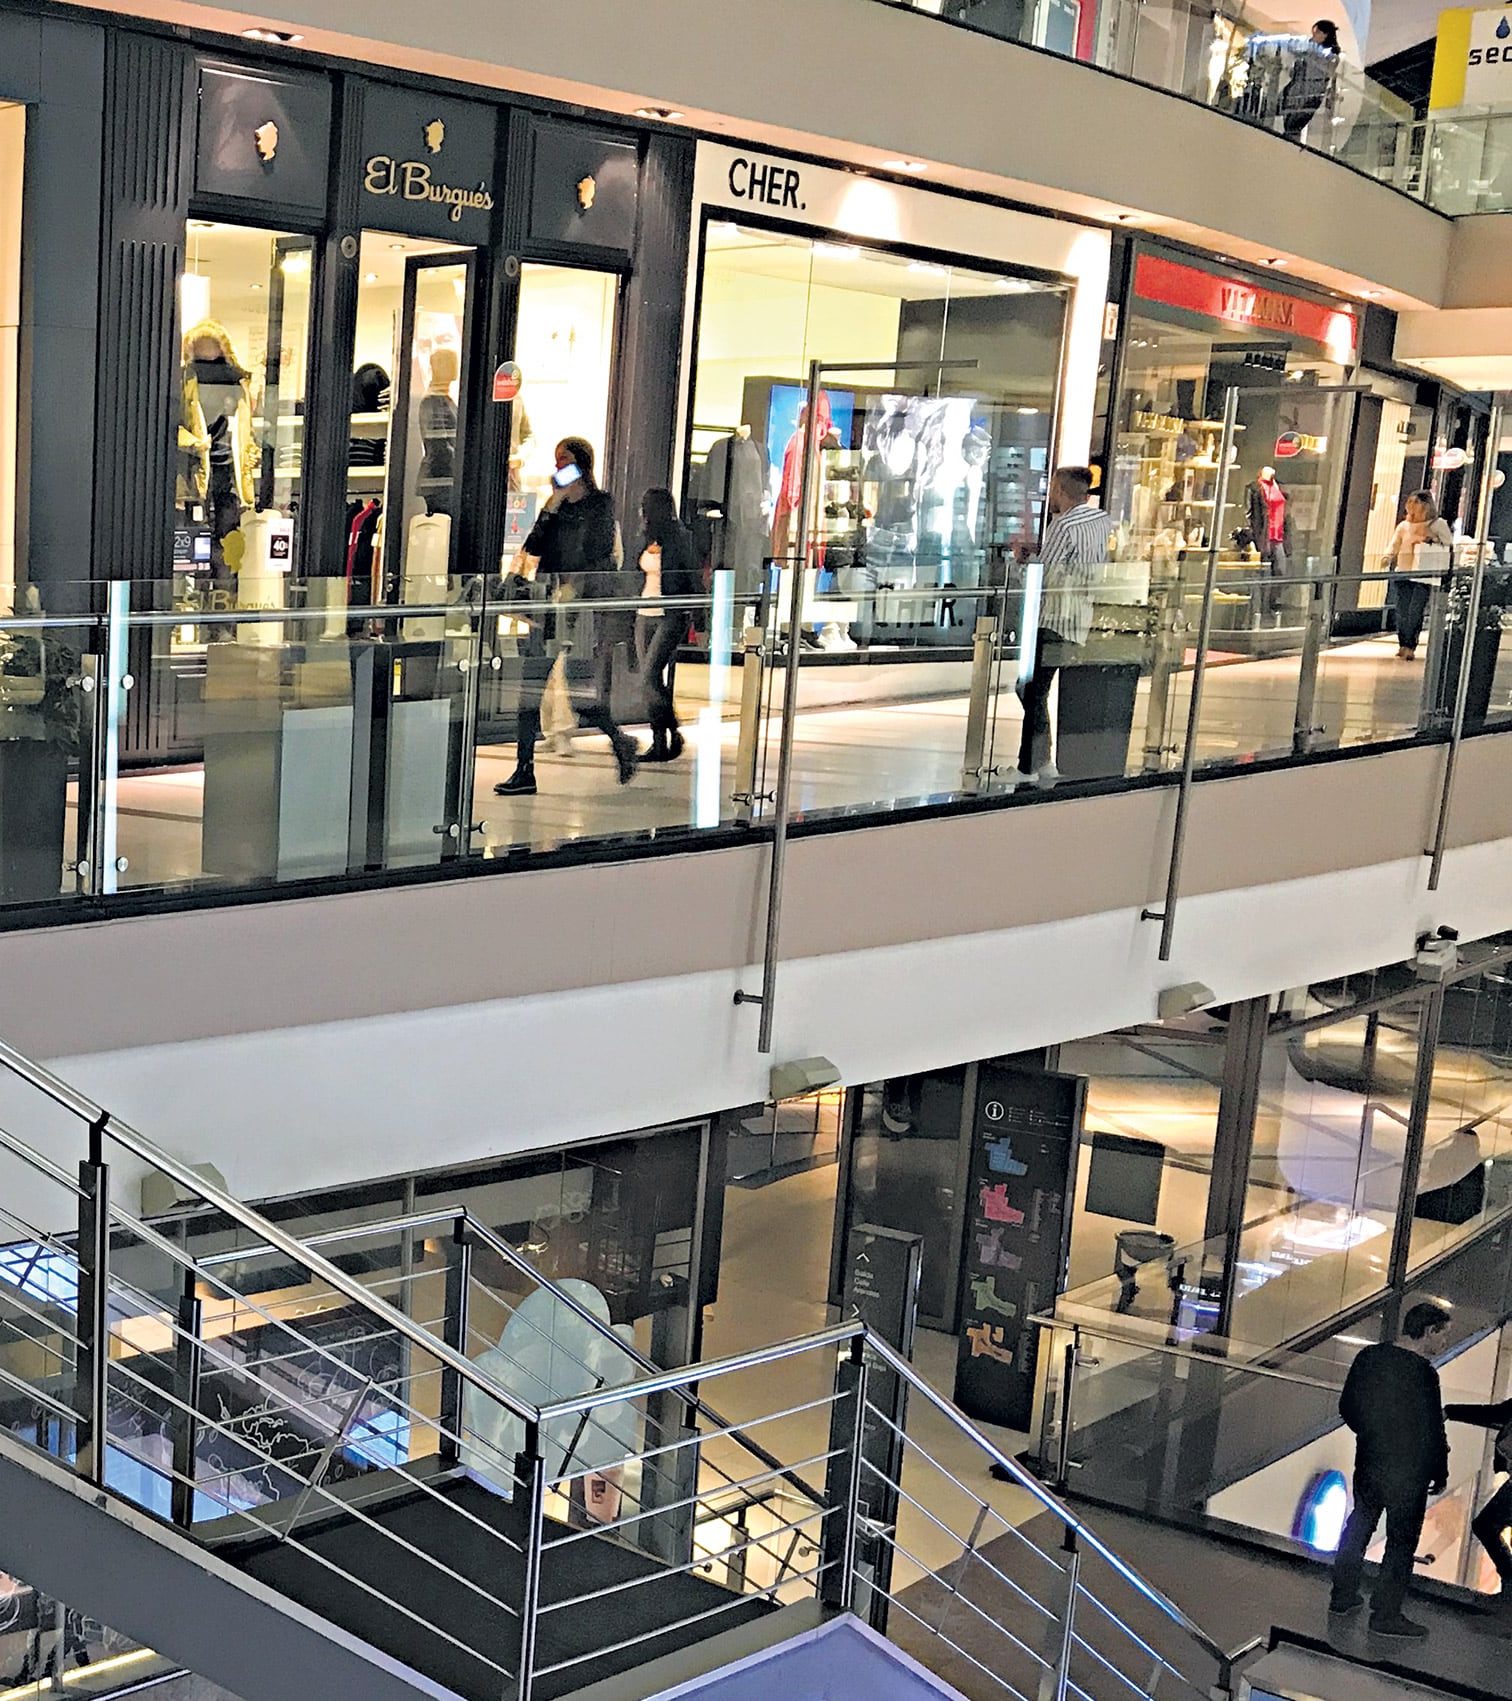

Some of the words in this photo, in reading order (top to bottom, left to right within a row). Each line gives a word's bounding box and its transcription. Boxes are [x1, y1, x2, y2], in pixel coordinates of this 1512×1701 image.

[364, 155, 399, 195] El
[400, 161, 494, 222] Burgués
[728, 158, 806, 210] CHER.
